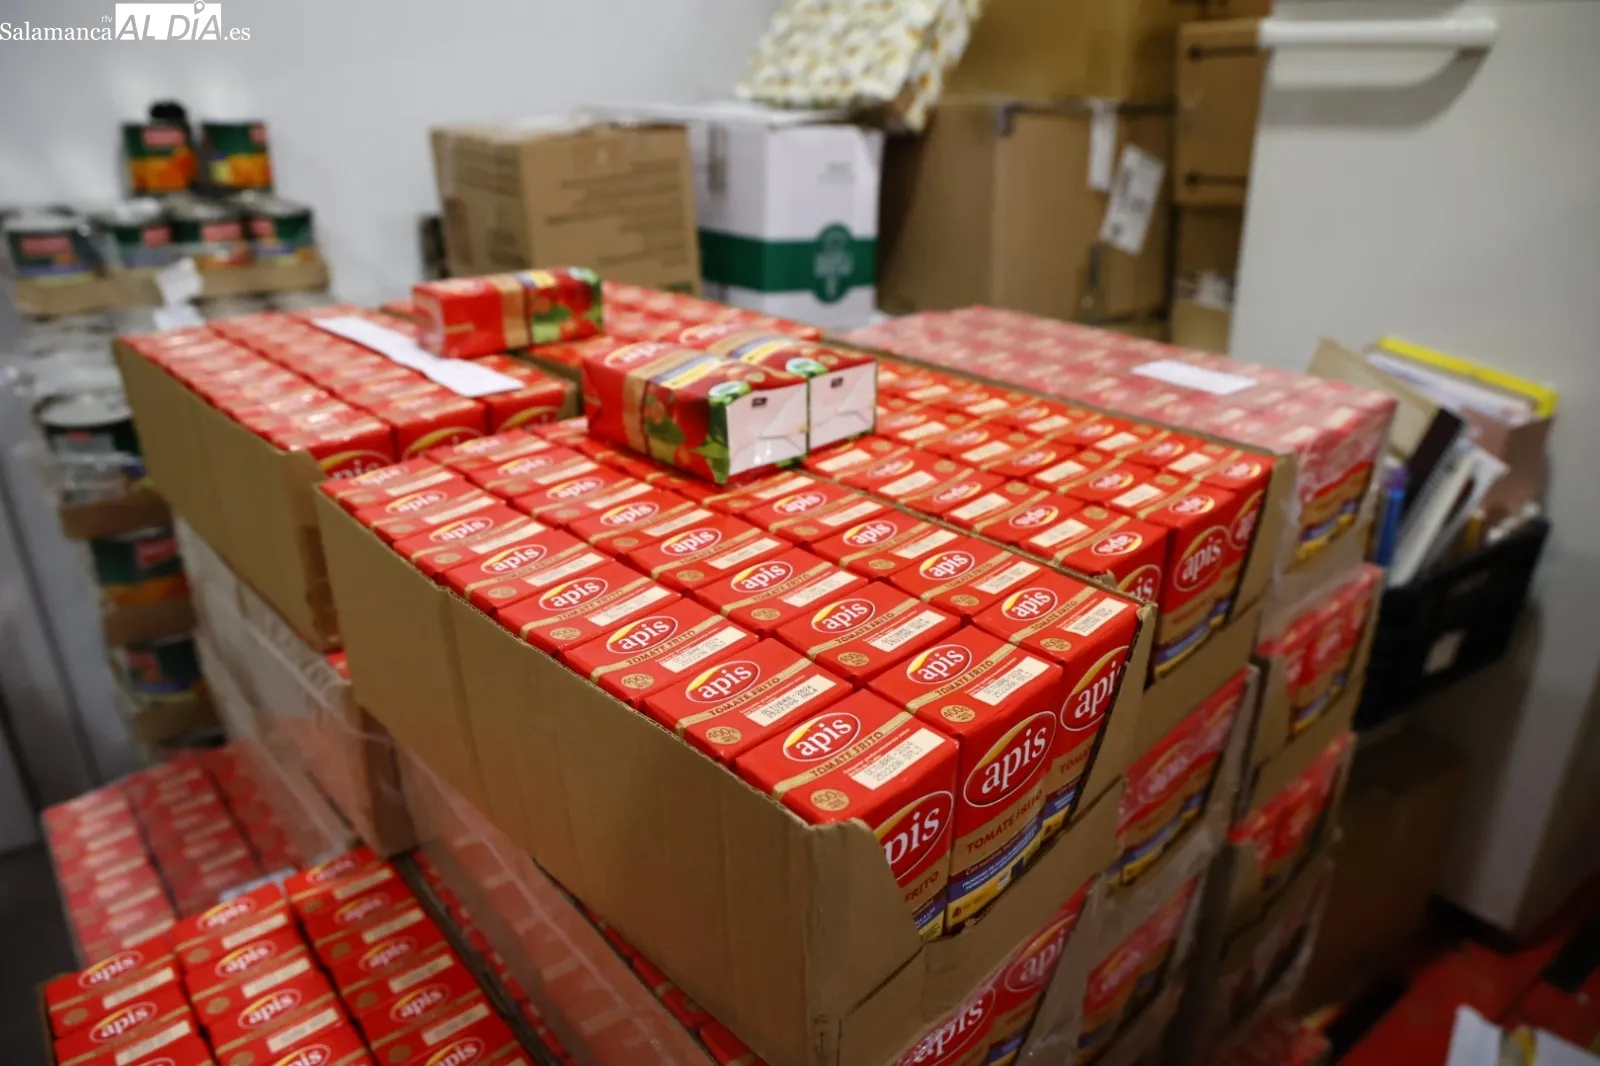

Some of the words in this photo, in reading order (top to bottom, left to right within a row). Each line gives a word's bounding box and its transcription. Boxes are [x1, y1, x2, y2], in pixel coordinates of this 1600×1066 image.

[611, 503, 652, 525] apis
[439, 519, 485, 541] apis
[672, 530, 715, 553] apis
[853, 522, 891, 544] apis
[492, 547, 540, 571] apis
[929, 554, 968, 578] apis
[1181, 535, 1221, 584] apis
[741, 564, 786, 590] apis
[551, 581, 600, 607] apis
[1011, 591, 1051, 617] apis
[821, 602, 868, 630] apis
[835, 622, 870, 644] TOMATE
[870, 612, 895, 631] FRITO
[618, 620, 670, 650] apis
[626, 645, 667, 666] TOMATE
[668, 629, 696, 648] FRITO
[918, 650, 965, 680] apis
[935, 675, 969, 697] TOMATE
[969, 660, 994, 681] FRITO
[698, 666, 752, 699] apis
[709, 693, 751, 717] TOMATE
[751, 677, 781, 699] FRITO
[1075, 661, 1121, 719] api
[796, 719, 852, 757] apis
[810, 750, 852, 778] TOMATE
[853, 732, 885, 755] FRITO
[981, 727, 1048, 793] apis
[884, 807, 940, 867] pis
[225, 946, 270, 974] apis
[1020, 927, 1069, 982] api
[89, 956, 135, 985] apis
[248, 992, 293, 1025] apis
[400, 989, 443, 1018] apis
[99, 1006, 148, 1039] apis
